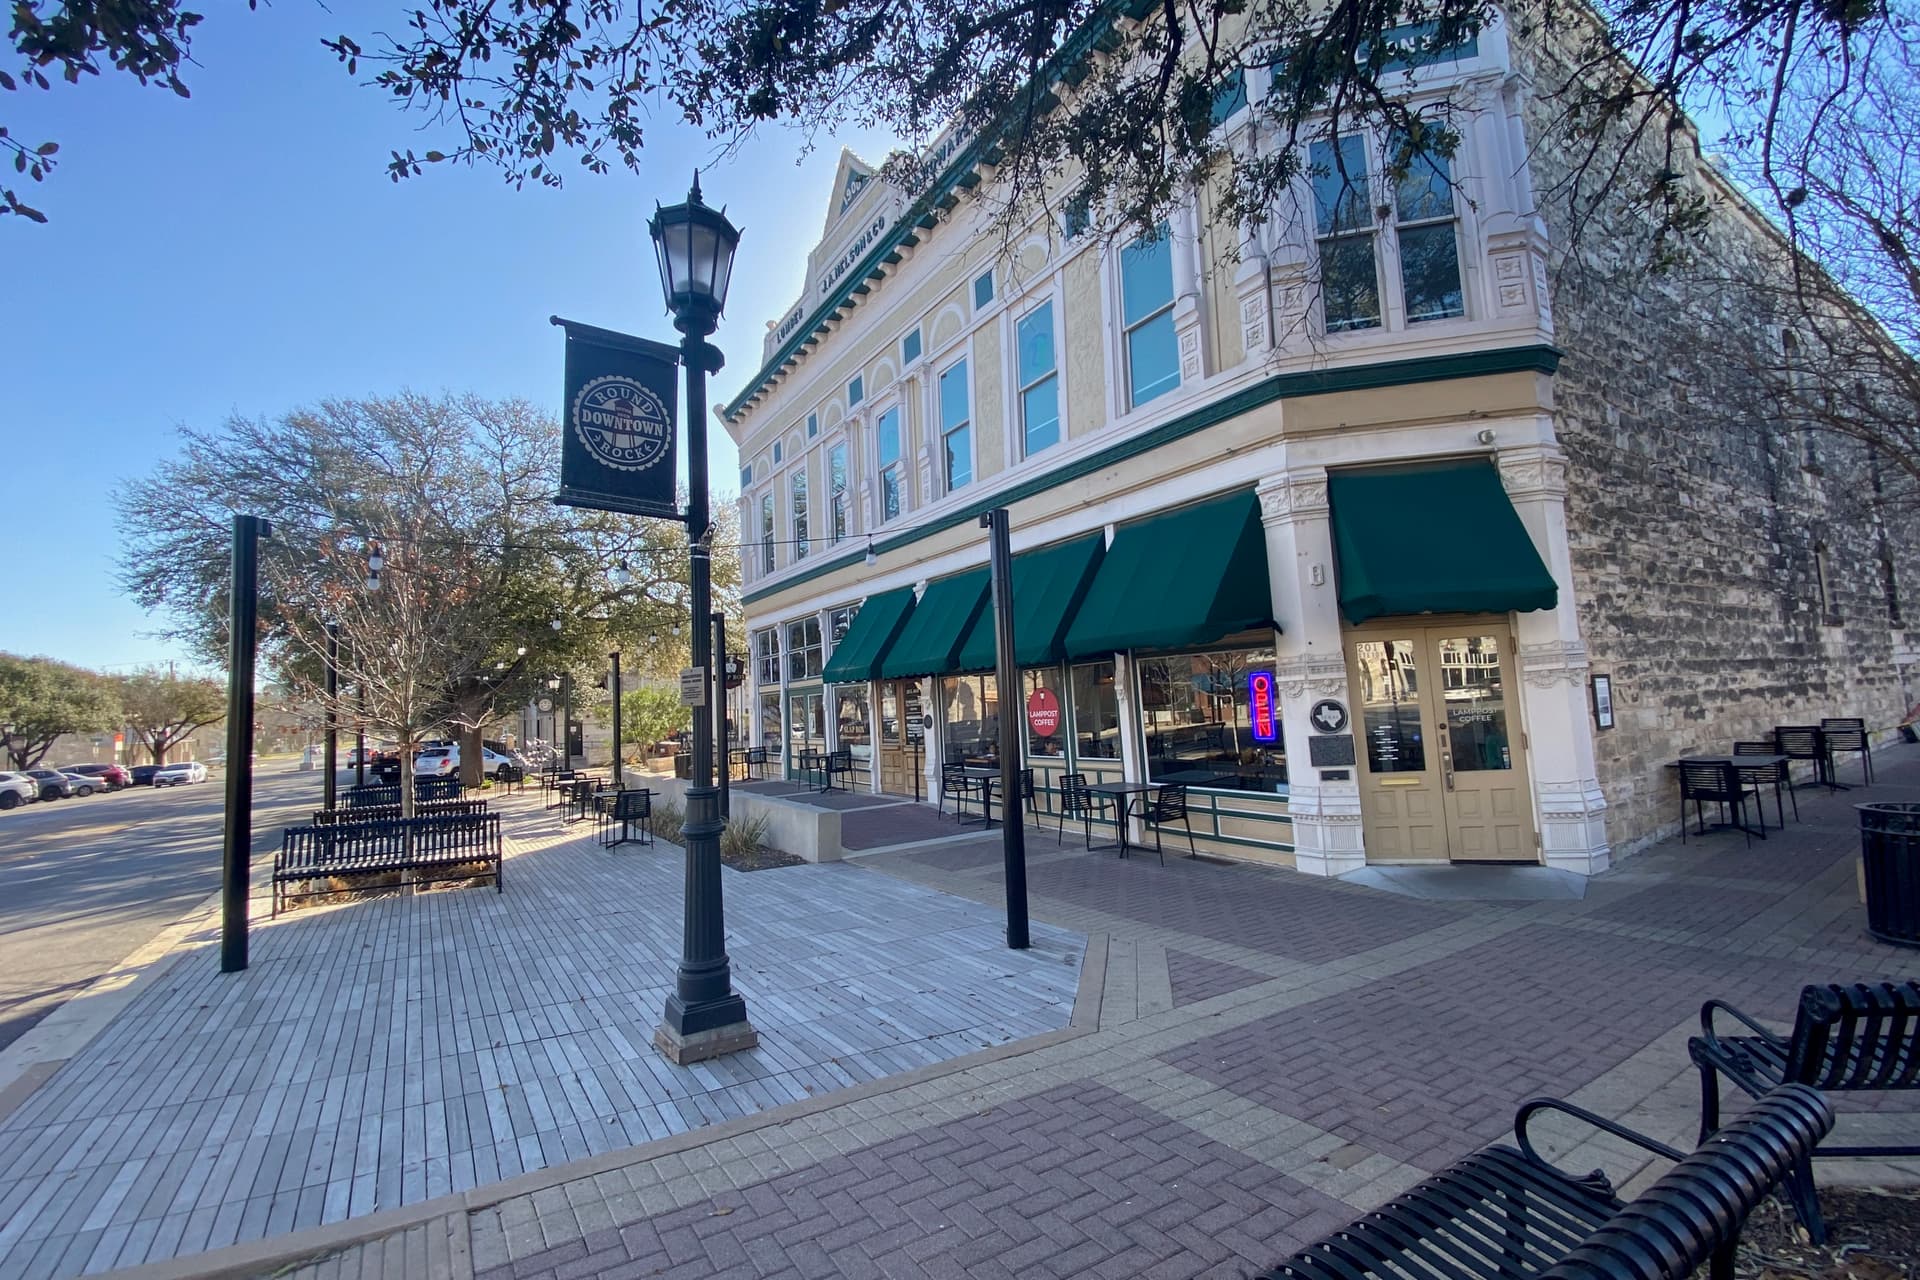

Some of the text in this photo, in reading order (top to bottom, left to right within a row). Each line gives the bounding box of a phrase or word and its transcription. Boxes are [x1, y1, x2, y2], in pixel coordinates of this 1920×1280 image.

[594, 387, 653, 413] ROUND
[582, 409, 663, 437] DOWNTOWN
[600, 442, 646, 460] ROCK
[1358, 643, 1377, 652] 201
[1029, 710, 1058, 718] LAMPPOST
[1254, 676, 1271, 737] OPEN
[1453, 707, 1497, 716] LAMPPOST
